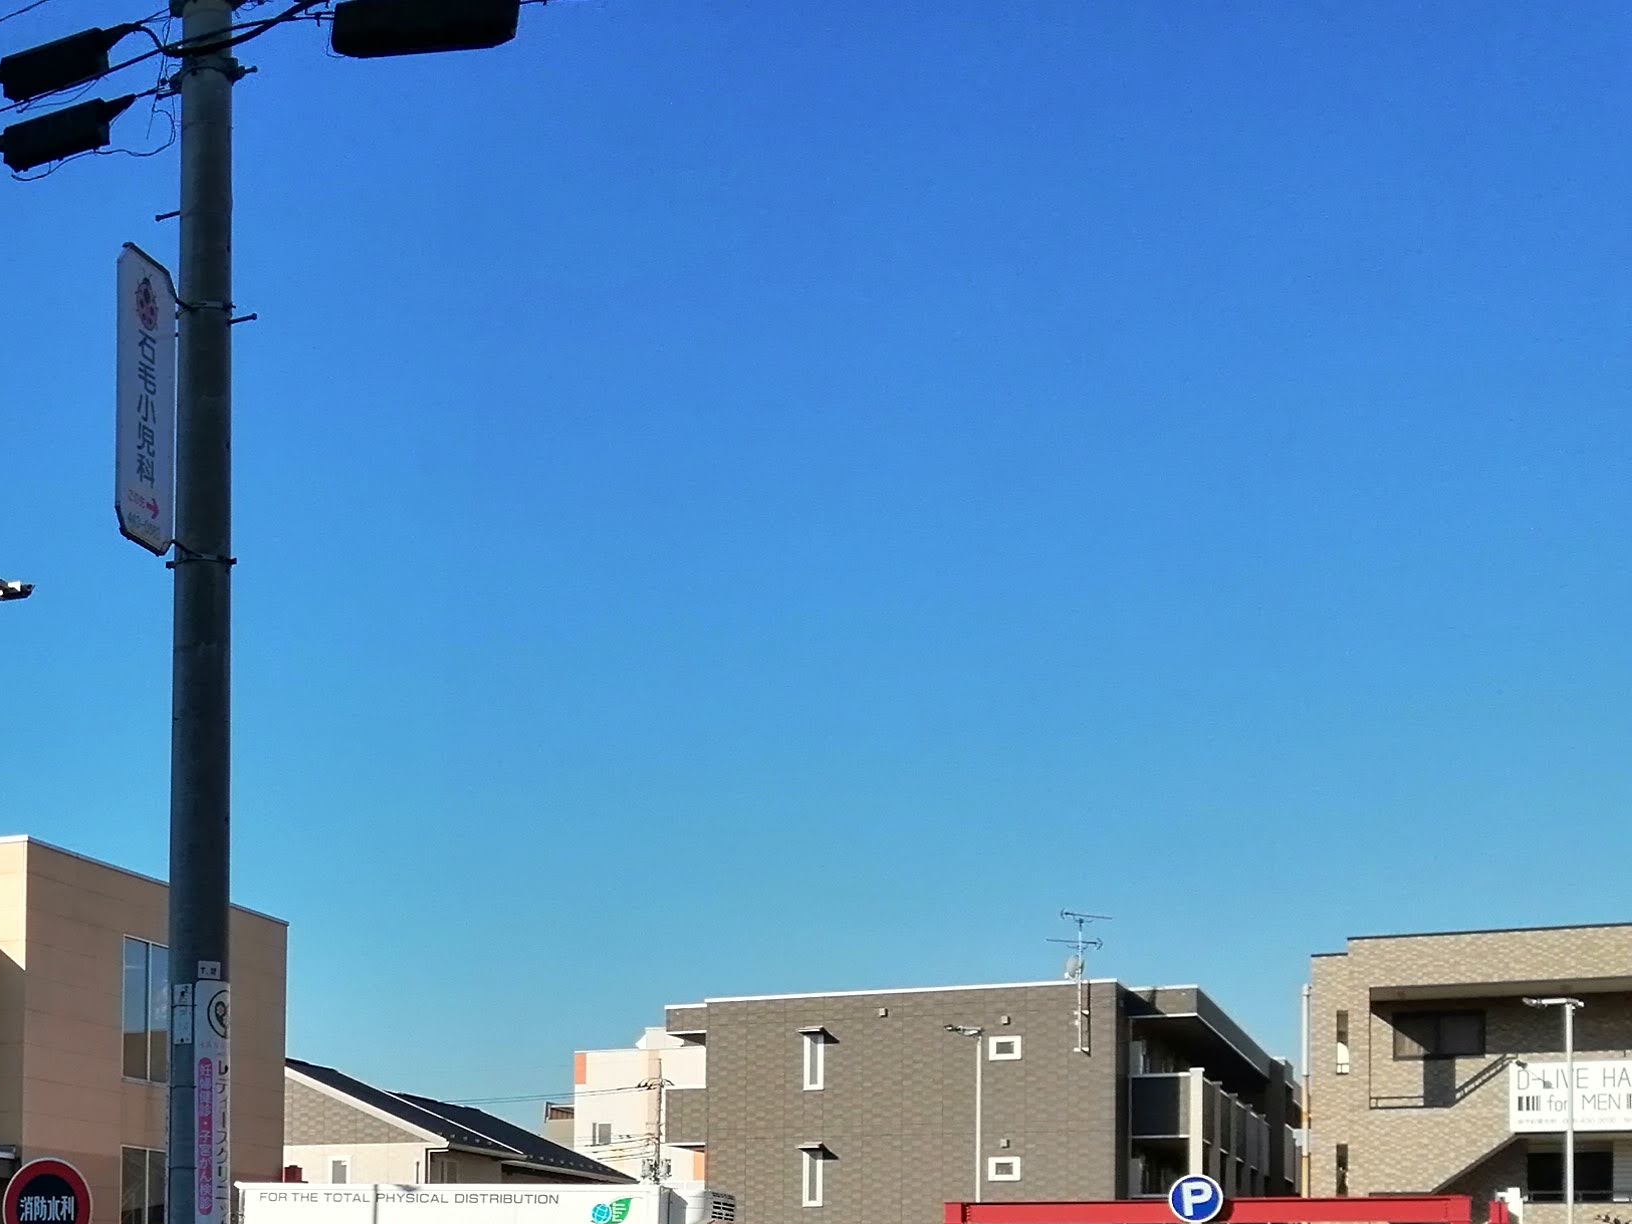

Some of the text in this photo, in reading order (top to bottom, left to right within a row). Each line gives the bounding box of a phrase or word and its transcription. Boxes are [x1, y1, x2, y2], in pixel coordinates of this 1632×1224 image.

[1582, 1093, 1621, 1111] MEN
[19, 1195, 75, 1222] 消防水利
[259, 1192, 560, 1205] FOR THE TOTAL PHYSICAL DISTRIBUTION
[1181, 1181, 1213, 1217] P
